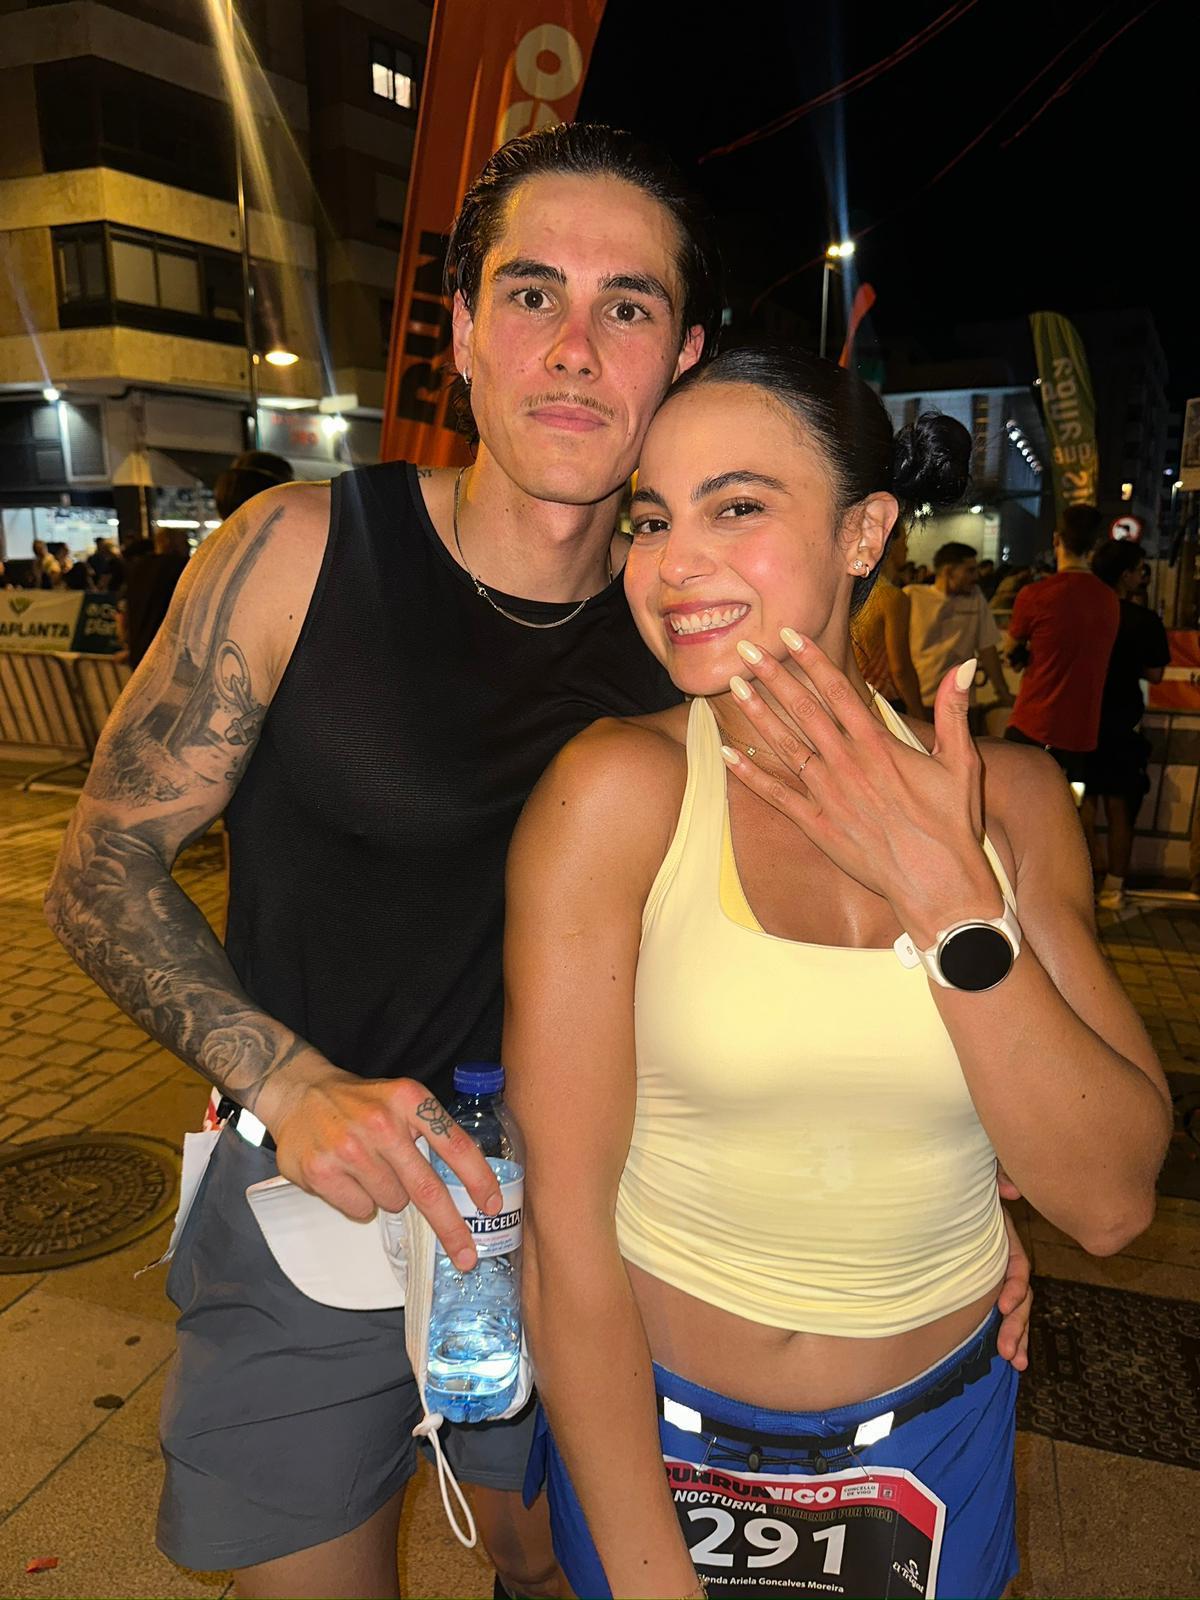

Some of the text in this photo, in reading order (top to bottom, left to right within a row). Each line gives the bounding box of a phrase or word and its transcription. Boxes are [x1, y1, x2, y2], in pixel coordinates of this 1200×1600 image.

[674, 1490, 767, 1514] NOCTURNA
[687, 1507, 847, 1576] 291
[730, 1576, 757, 1585] Ariela
[758, 1577, 806, 1589] Goncalves
[807, 1581, 844, 1593] Moreira
